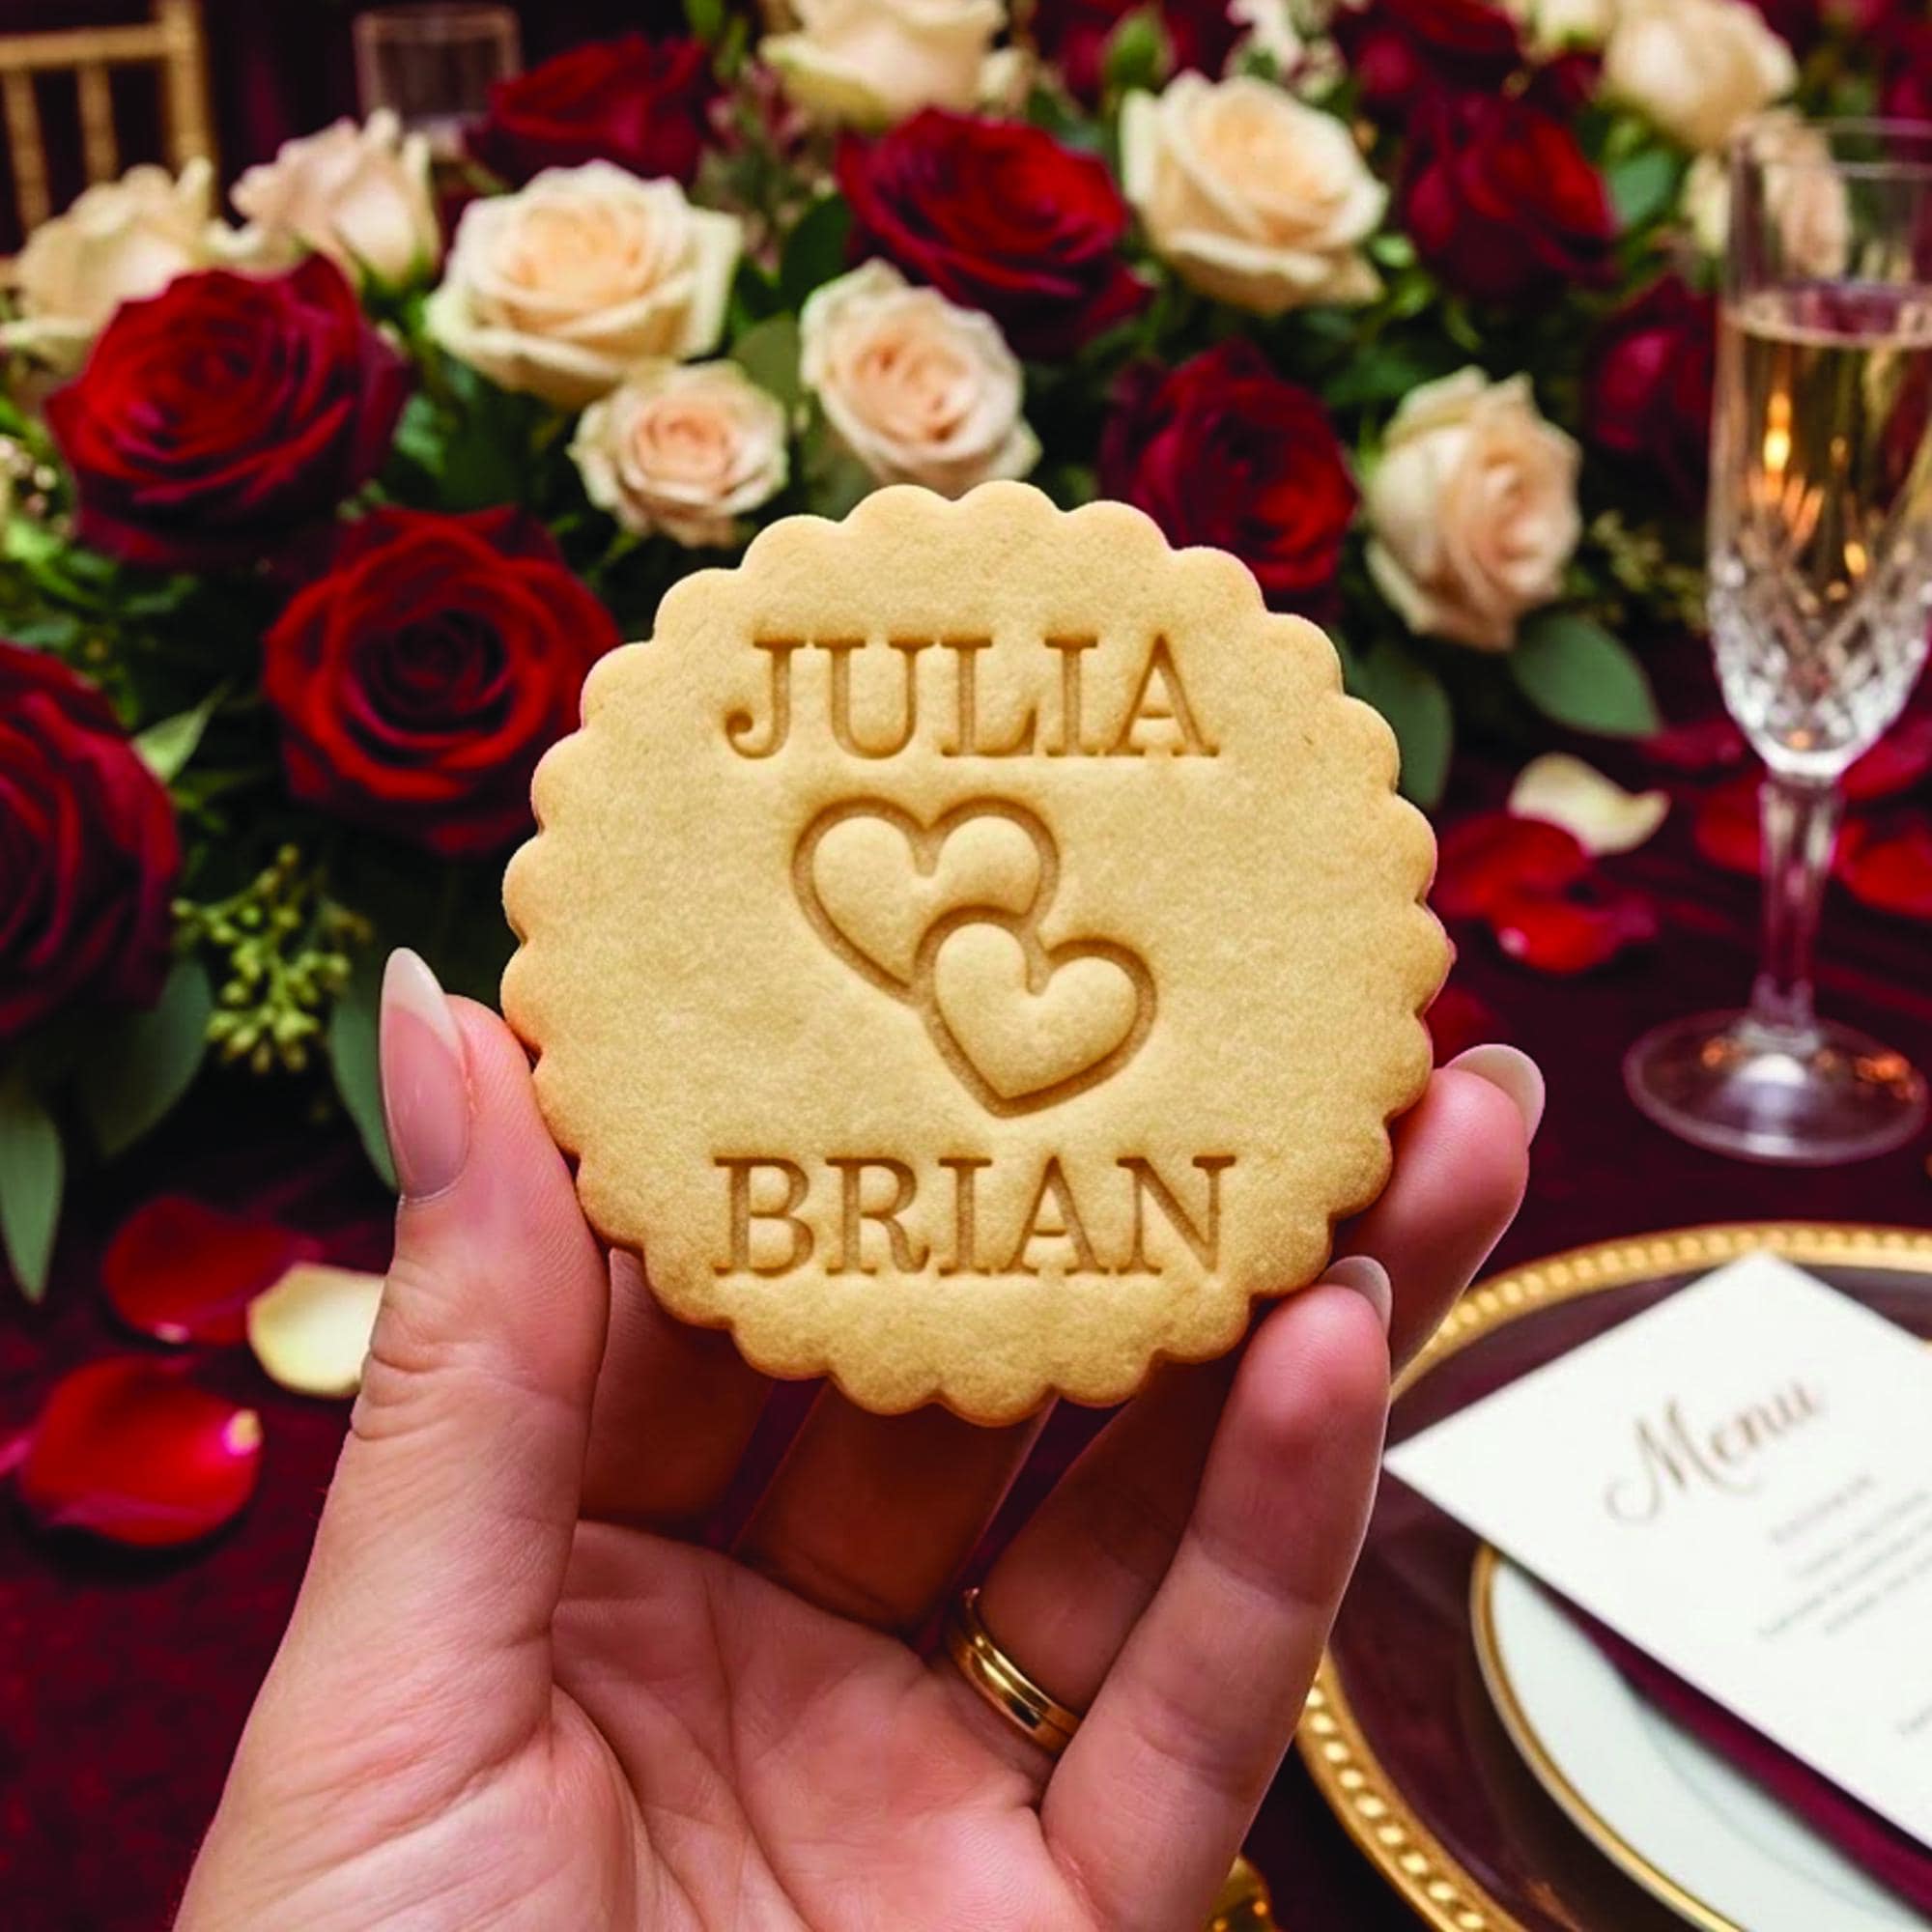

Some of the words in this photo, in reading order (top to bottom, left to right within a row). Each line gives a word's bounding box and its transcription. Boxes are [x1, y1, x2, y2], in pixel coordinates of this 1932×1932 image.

[724, 633, 1220, 759] JULIA
[713, 1154, 1236, 1277] BRIAN
[1605, 1378, 1822, 1522] Menu
